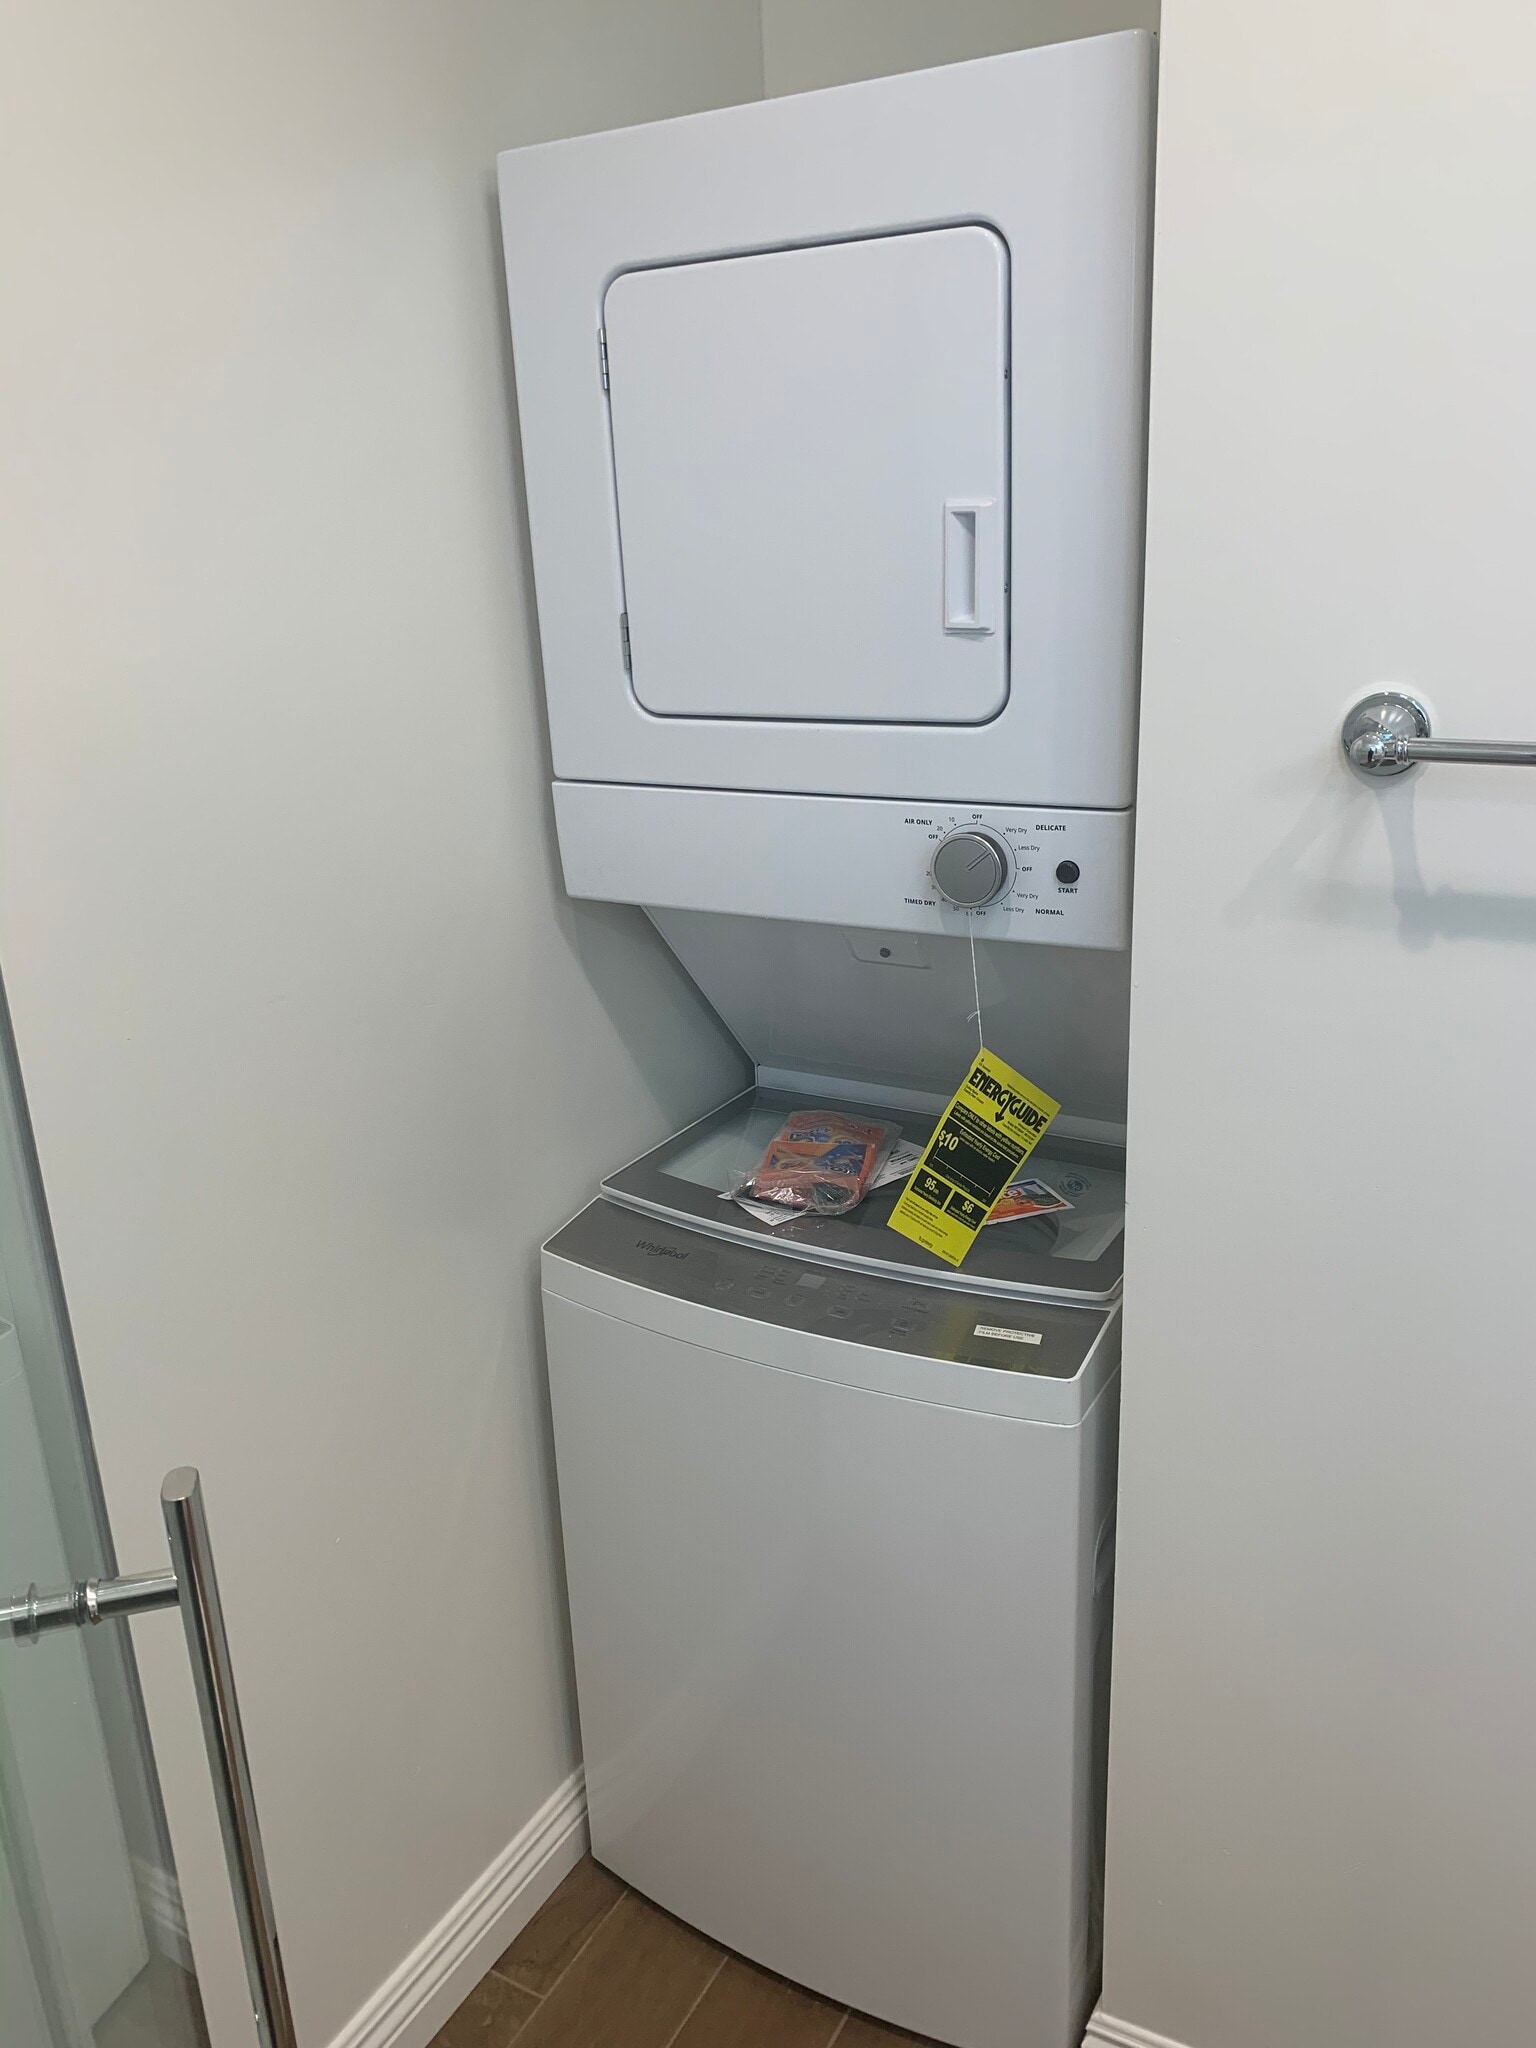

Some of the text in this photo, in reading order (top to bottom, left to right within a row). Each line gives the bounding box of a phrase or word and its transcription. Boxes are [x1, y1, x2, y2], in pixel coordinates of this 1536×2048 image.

[968, 1067, 1048, 1134] ENERGYGUIDE
[939, 1129, 959, 1151] $10
[924, 1177, 935, 1191] 95
[961, 1200, 975, 1213] $6
[636, 1240, 690, 1260] Whirlpool
